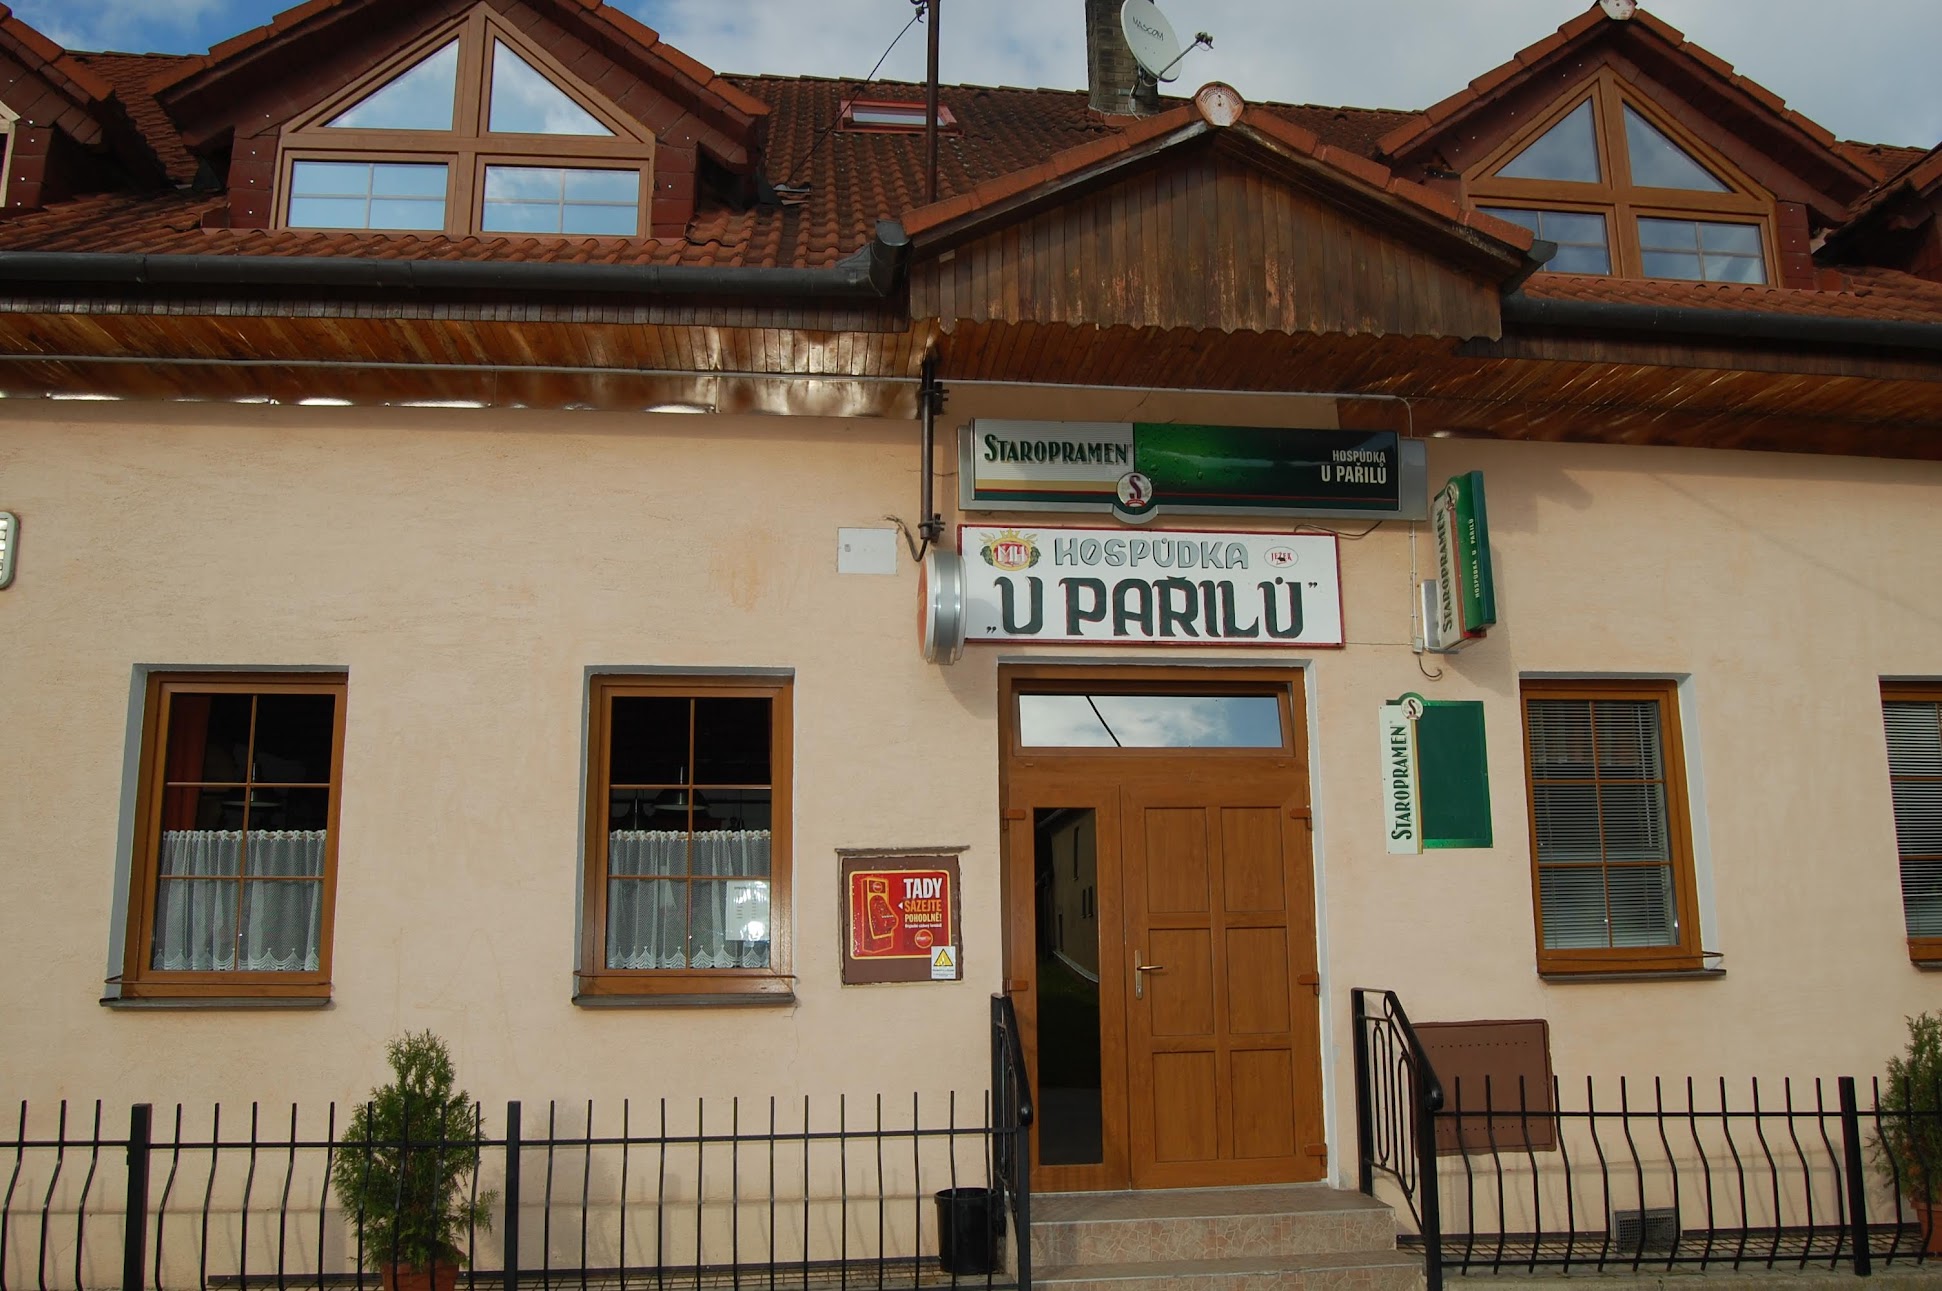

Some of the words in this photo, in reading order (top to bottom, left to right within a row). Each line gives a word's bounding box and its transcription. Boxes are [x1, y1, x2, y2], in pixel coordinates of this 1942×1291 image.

[984, 433, 1128, 464] STAROPRAMEN
[1332, 448, 1386, 463] HOSPŮDKA
[1321, 465, 1331, 482] U
[1336, 462, 1387, 484] PAŘILŮ
[1054, 538, 1249, 569] HOSPŮDKA
[1437, 509, 1453, 633] STAROPRAMEN
[1390, 726, 1413, 841] STAROPRAMEN
[903, 877, 943, 899] TADY
